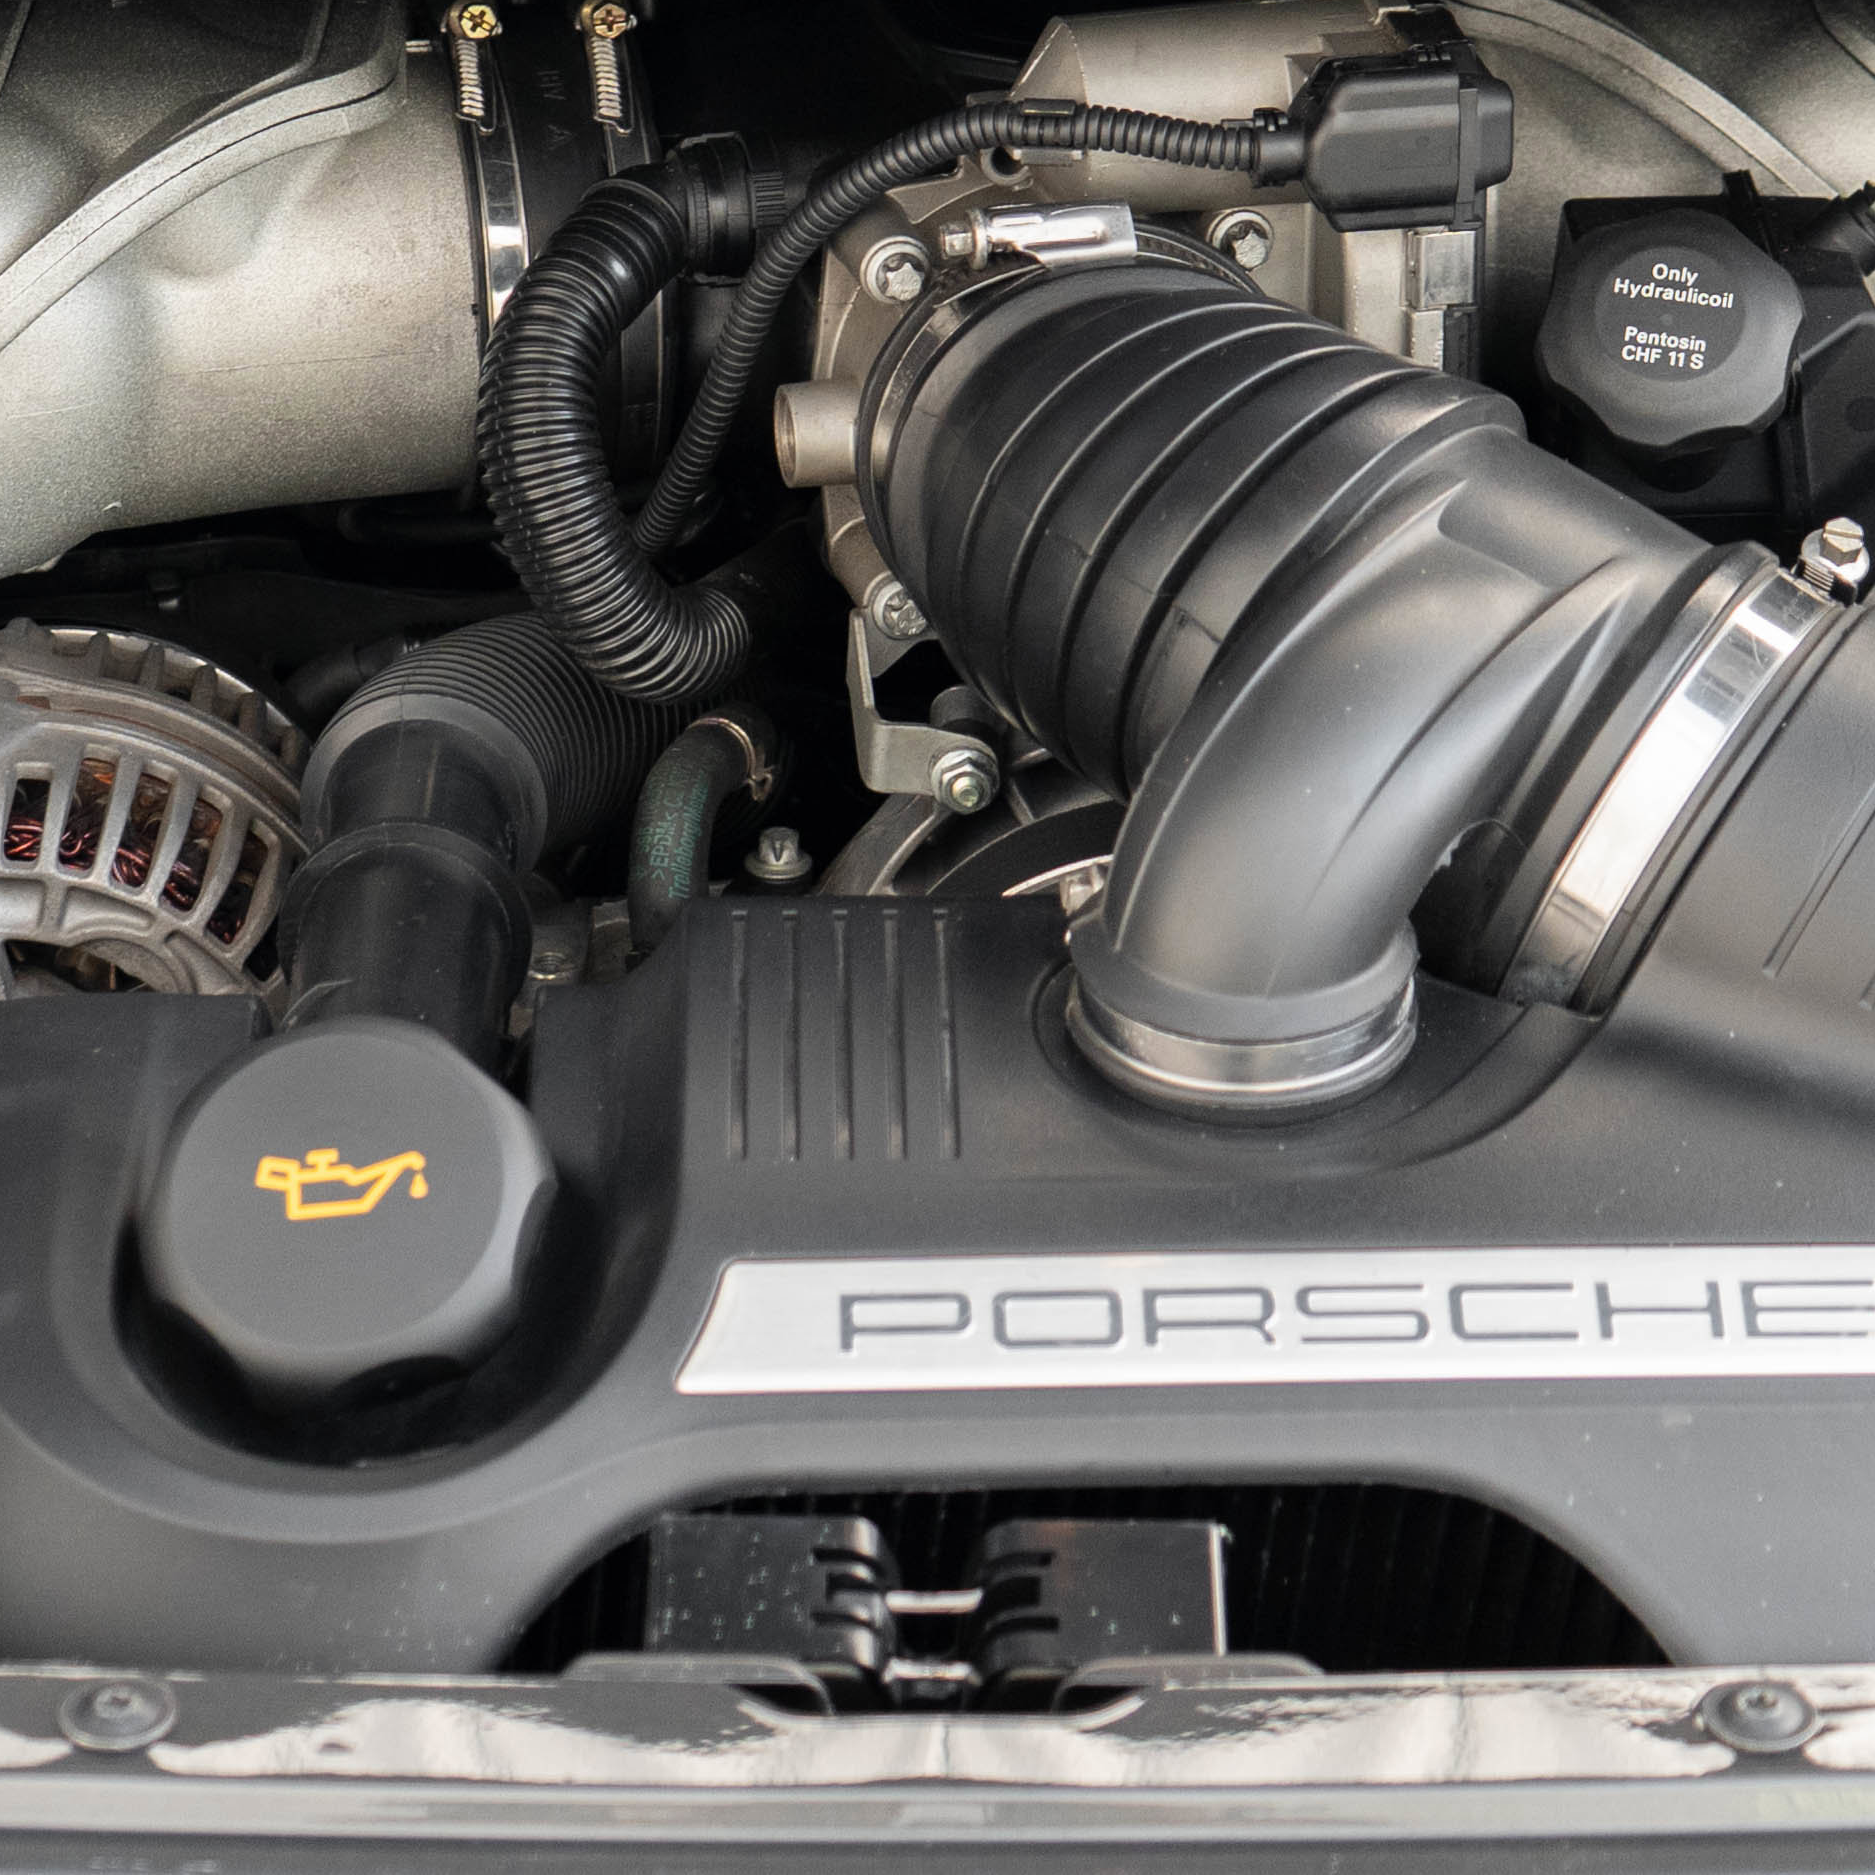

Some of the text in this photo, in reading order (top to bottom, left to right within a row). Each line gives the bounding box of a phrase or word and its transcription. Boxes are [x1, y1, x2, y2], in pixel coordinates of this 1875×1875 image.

[1651, 263, 1699, 286] Only
[1613, 277, 1734, 309] Hydraulicoil
[1624, 325, 1706, 352] Pentosin
[1621, 345, 1705, 370] CHF 11 S
